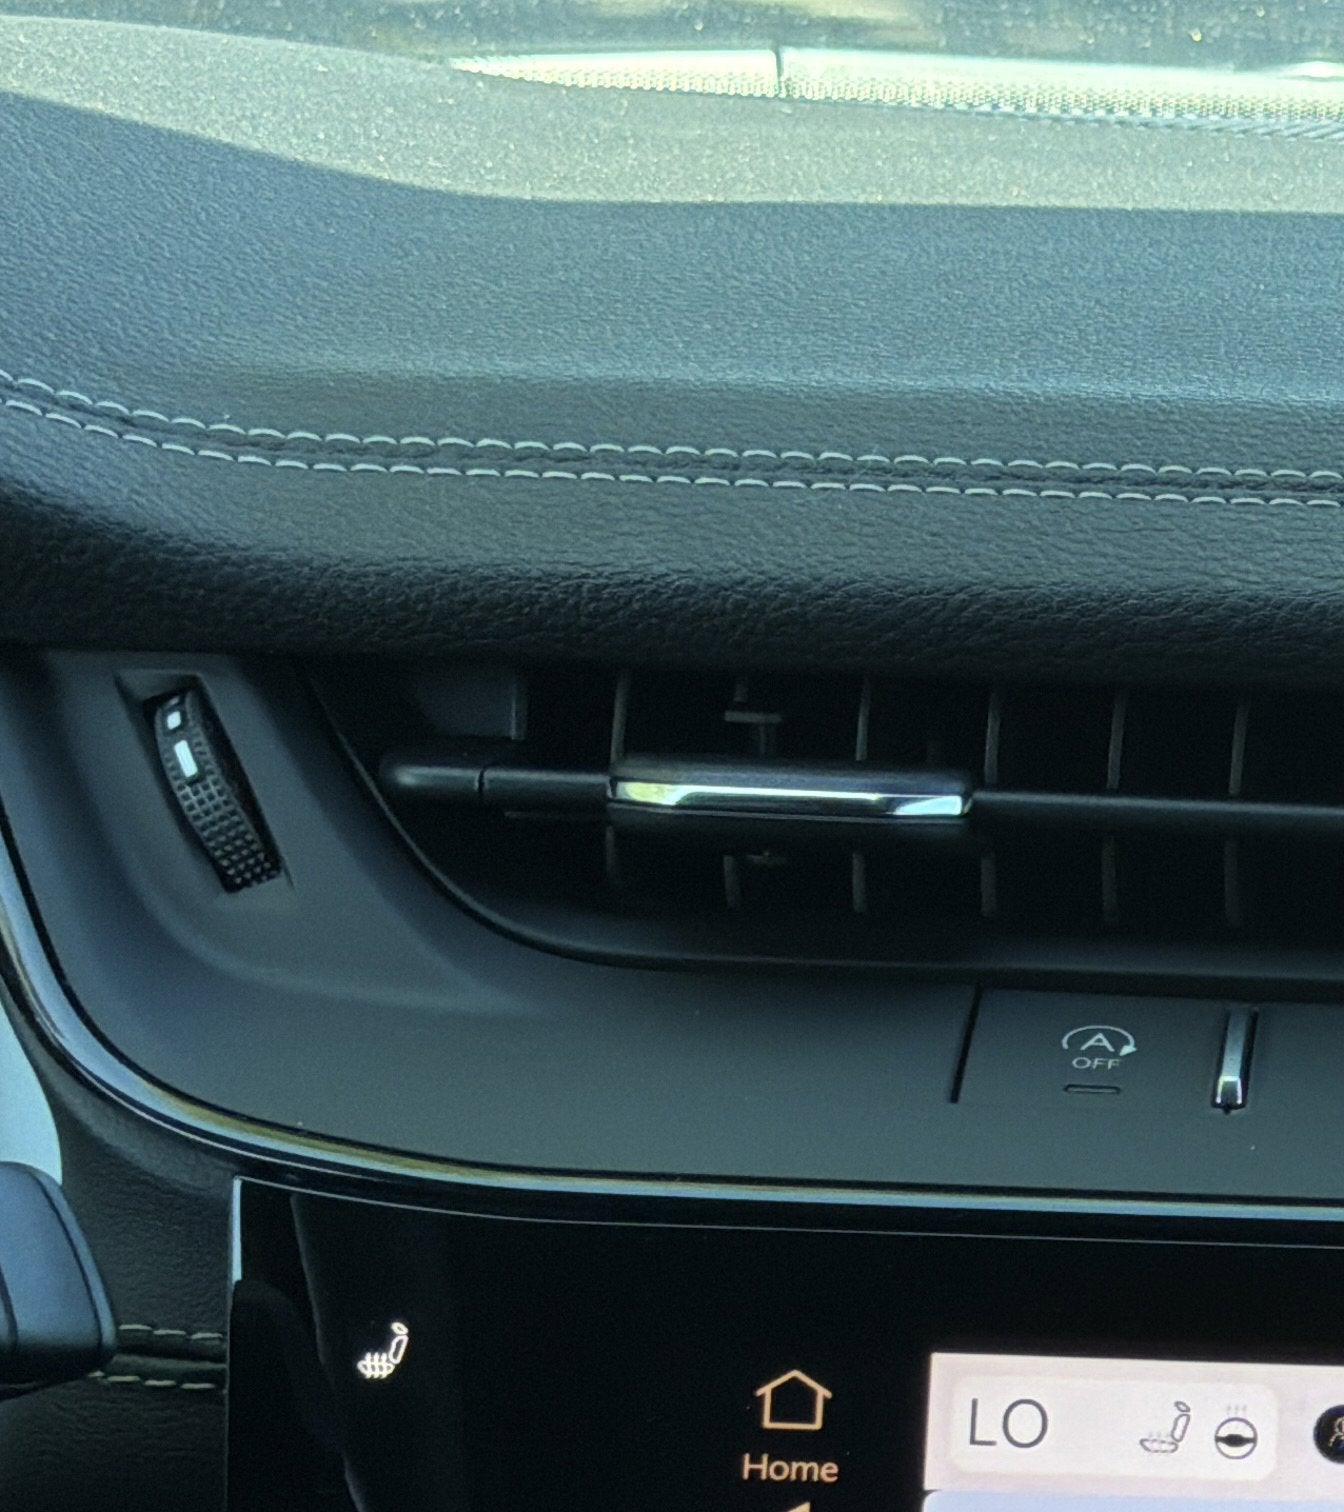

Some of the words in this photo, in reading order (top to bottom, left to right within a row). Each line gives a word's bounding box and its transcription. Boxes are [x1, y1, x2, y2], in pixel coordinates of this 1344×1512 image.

[1072, 1057, 1120, 1069] OFF
[968, 1398, 1049, 1449] LO
[741, 1453, 839, 1482] Home
